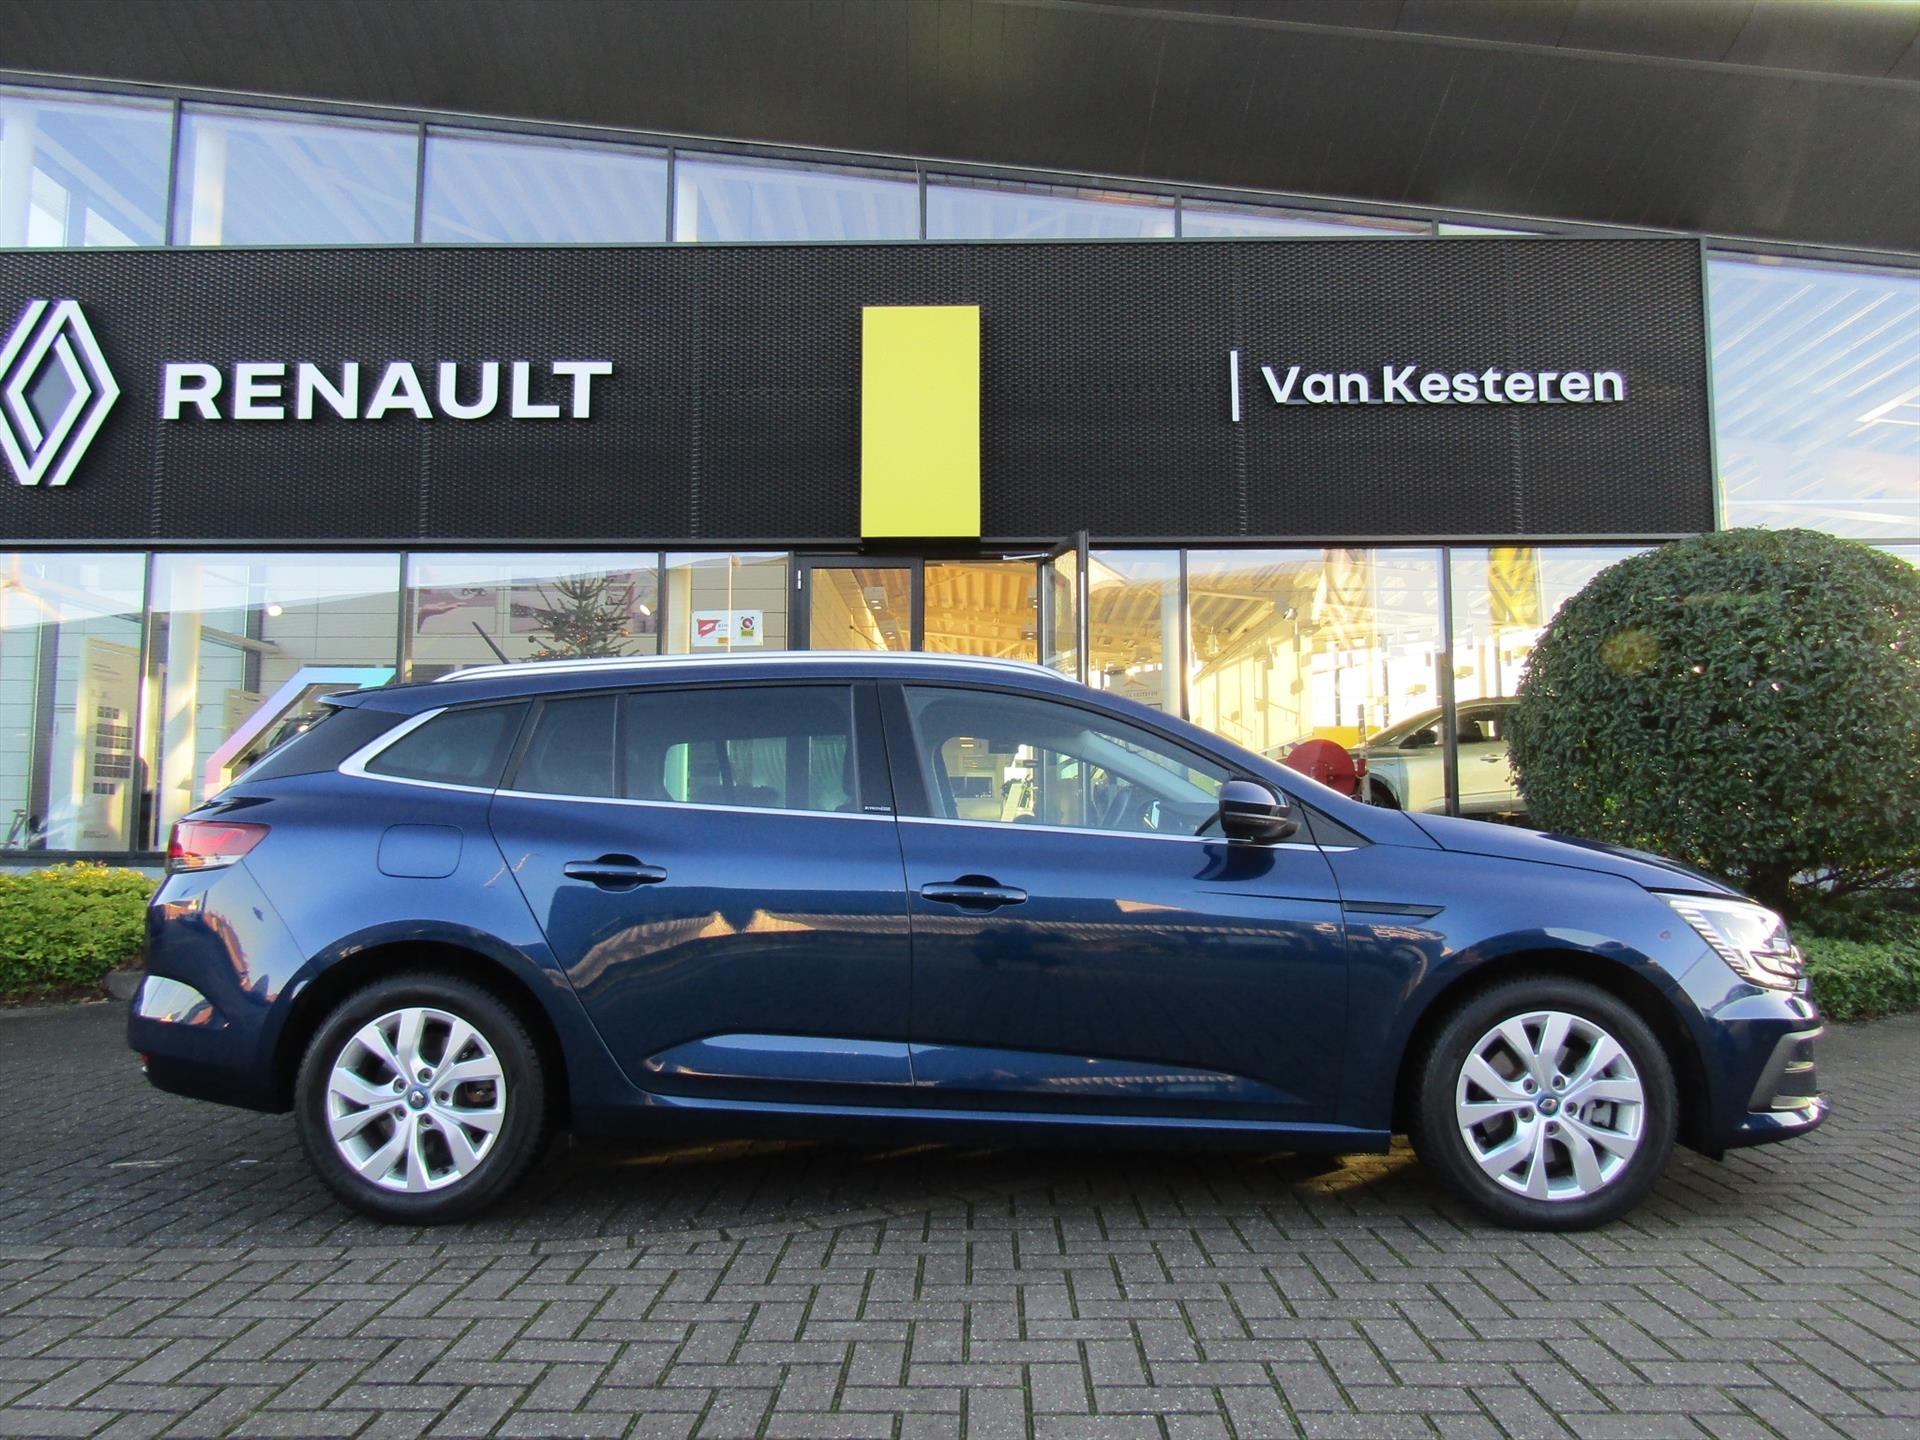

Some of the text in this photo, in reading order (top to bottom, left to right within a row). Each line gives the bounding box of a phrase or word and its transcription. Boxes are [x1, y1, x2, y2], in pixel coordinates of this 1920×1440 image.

[161, 361, 613, 420] RENAULT
[1261, 365, 1624, 403] Van Kesteren
